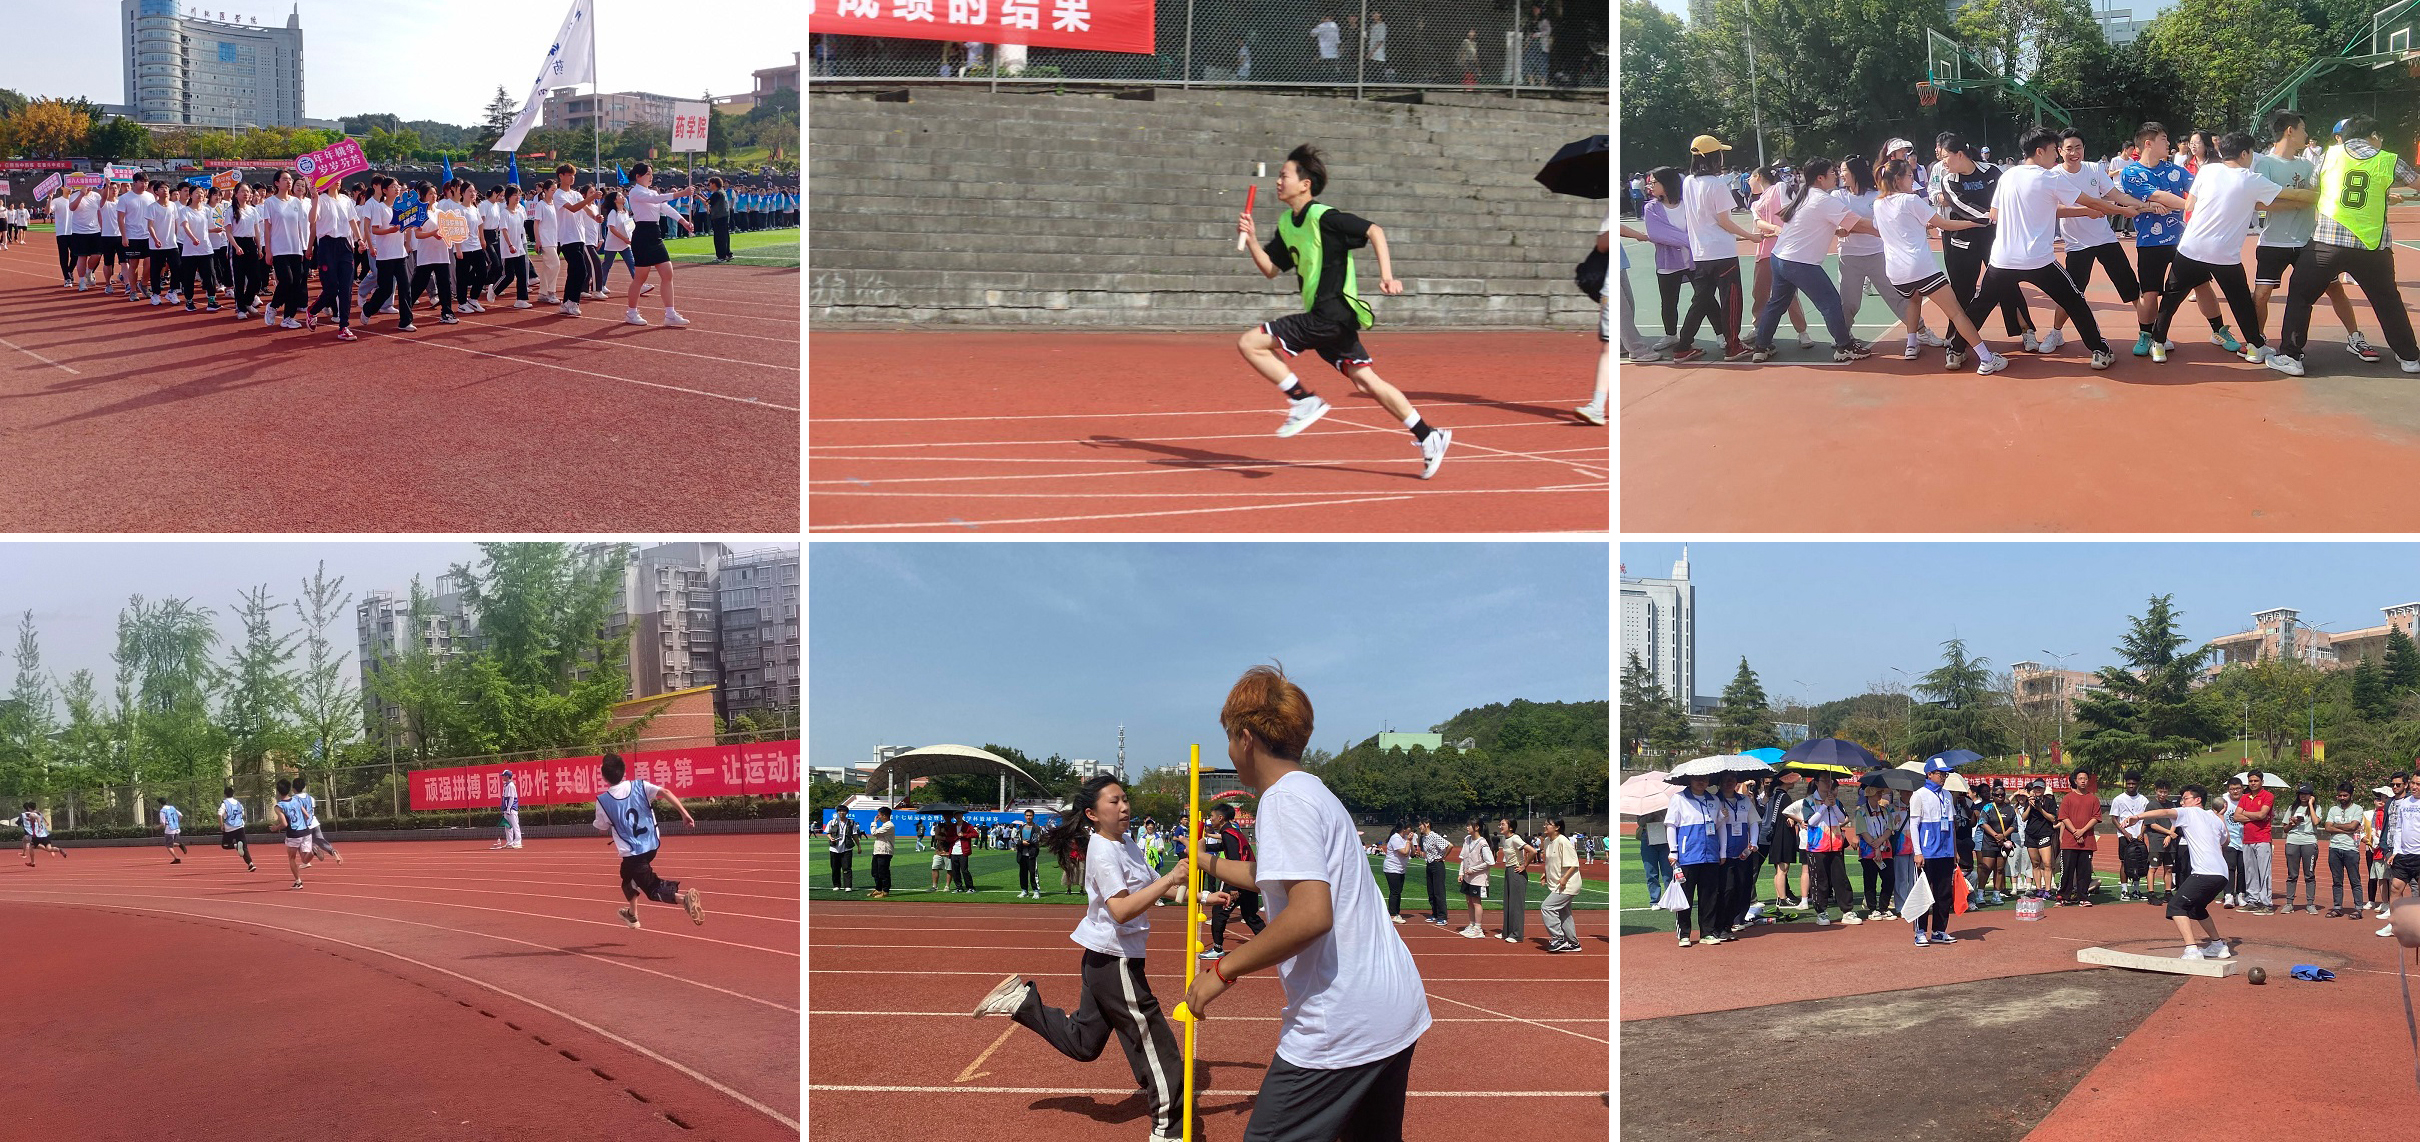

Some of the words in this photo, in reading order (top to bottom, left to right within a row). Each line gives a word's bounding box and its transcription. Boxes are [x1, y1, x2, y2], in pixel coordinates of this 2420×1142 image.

[191, 7, 257, 24] 川北医学院
[809, 0, 1091, 32] 成绩的结果
[675, 115, 707, 139] 药学院
[313, 143, 356, 164] 年年桃李
[318, 154, 361, 176] 岁岁芬芳
[2341, 169, 2371, 210] 8
[424, 774, 482, 802] 顽强拼搏
[486, 769, 549, 799] 团协作
[556, 763, 626, 795] 共创佳
[633, 758, 715, 789] 勇争第一
[626, 808, 648, 838] 2
